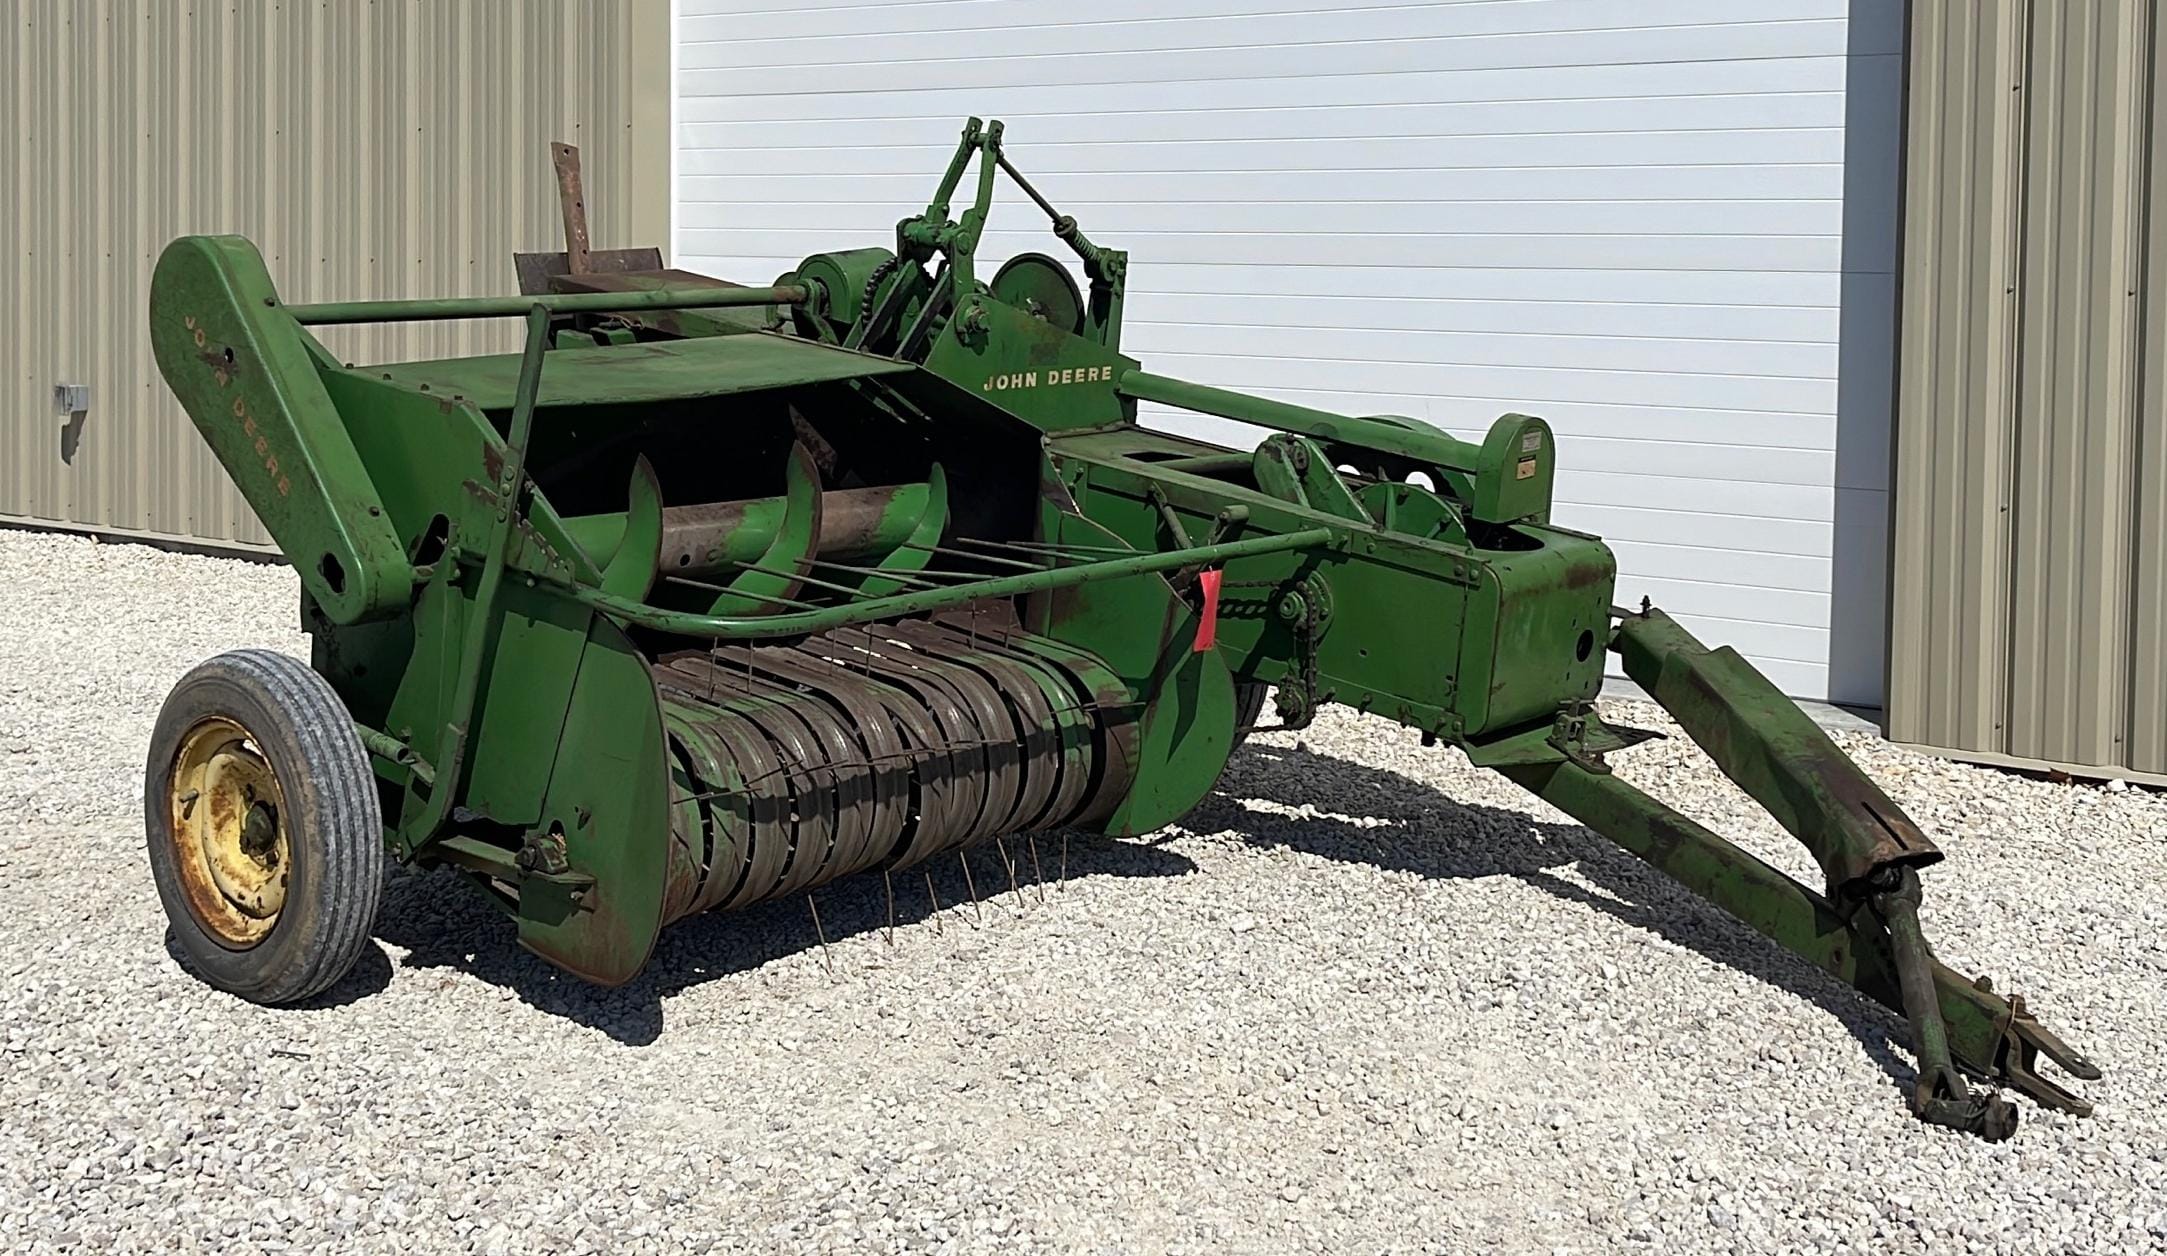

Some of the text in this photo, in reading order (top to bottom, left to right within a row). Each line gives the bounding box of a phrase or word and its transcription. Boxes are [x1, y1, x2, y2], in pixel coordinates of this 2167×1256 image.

[185, 315, 289, 496] JON DEERE
[983, 366, 1112, 391] JOHN DEERE
